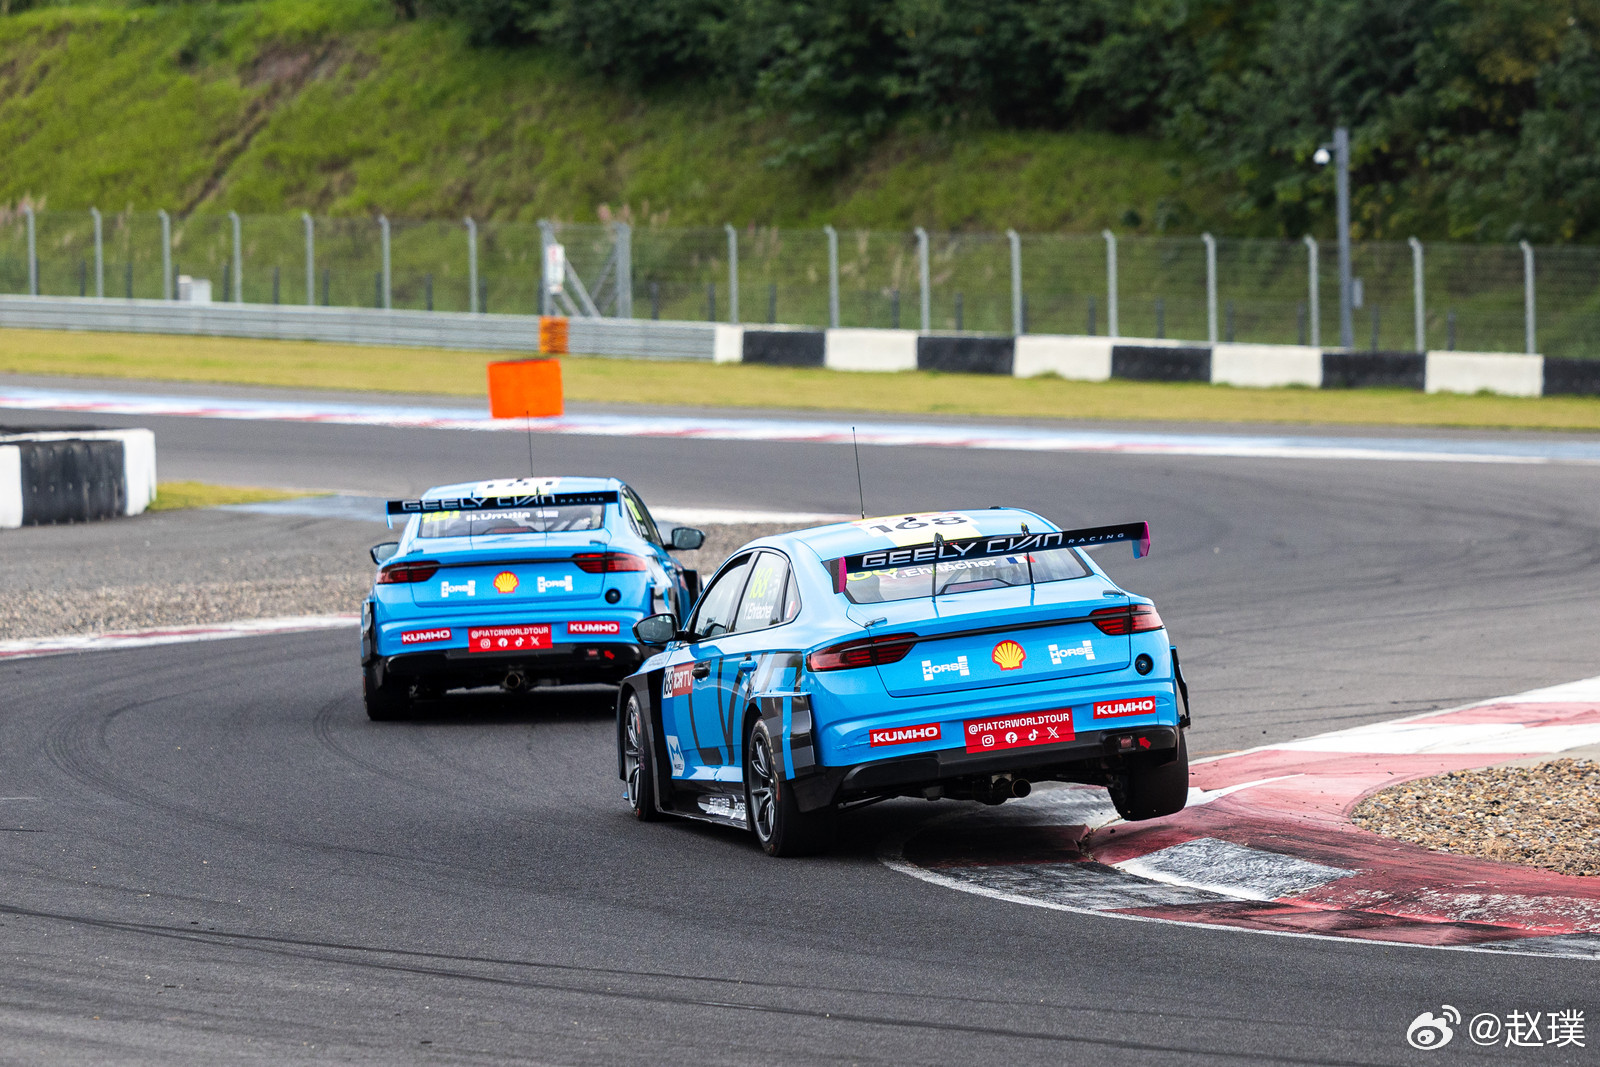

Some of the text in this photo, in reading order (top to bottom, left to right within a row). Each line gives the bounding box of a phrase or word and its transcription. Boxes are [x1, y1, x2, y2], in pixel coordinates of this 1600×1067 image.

[402, 497, 487, 511] GEELY
[870, 517, 967, 533] 168
[862, 541, 977, 568] GEELY
[1068, 533, 1124, 544] RACING
[471, 627, 549, 639] @FIATCRWORLDTOUR
[570, 622, 618, 633] KUMHO
[402, 630, 450, 643] KUMHO
[1048, 642, 1095, 662] HORSE
[921, 658, 970, 679] HORSE
[1096, 699, 1154, 716] KUMHO
[968, 713, 1070, 735] @FIATCRWORLDTOUR
[873, 726, 938, 743] KUMHO
